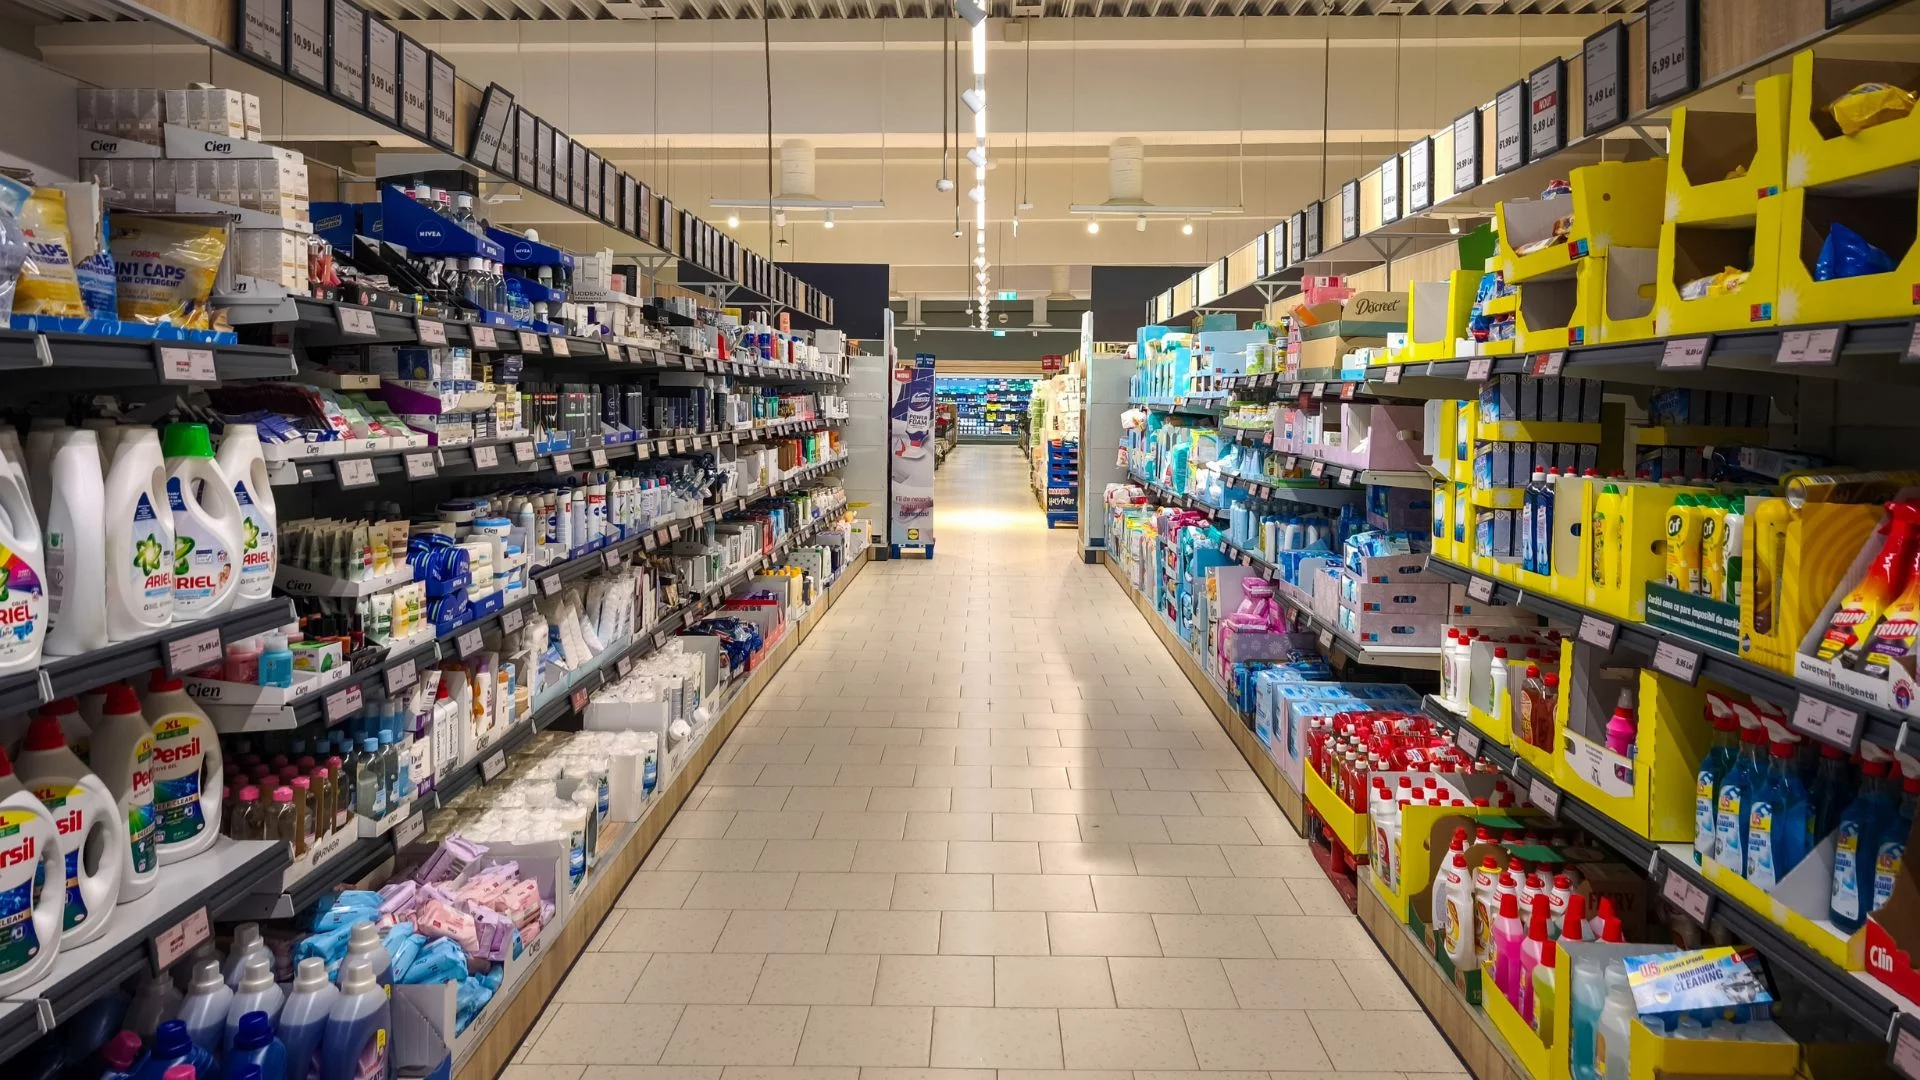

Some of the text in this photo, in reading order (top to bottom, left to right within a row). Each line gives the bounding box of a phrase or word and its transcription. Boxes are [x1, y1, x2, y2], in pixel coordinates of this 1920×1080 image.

[293, 32, 323, 58] 10,99 Lei
[1652, 47, 1685, 75] 6,99 Lei
[371, 73, 394, 96] 9,99 Lei
[404, 91, 425, 112] 6,99 Lei
[1588, 82, 1616, 108] 3,49 Lei
[1533, 114, 1556, 135] 9,89 Lei
[90, 140, 118, 153] Cien
[204, 140, 232, 153] Cien
[28, 241, 68, 257] CAPS
[143, 262, 187, 280] CAPS
[135, 277, 181, 288] DETERGENT
[1355, 298, 1401, 315] Discreet
[306, 444, 320, 455] Cien
[1668, 517, 1681, 534] Cif
[243, 550, 270, 566] ARIEL
[144, 572, 172, 589] ARIEL
[174, 576, 216, 590] RIEL
[0, 605, 34, 625] RIEL
[1830, 611, 1870, 625] TRIUMF
[211, 639, 220, 649] Lei
[1685, 662, 1693, 670] Lei
[186, 684, 221, 699] Cien
[165, 719, 182, 730] XL
[153, 736, 201, 762] Persil
[56, 809, 83, 836] sil
[0, 837, 34, 869] rsil
[0, 912, 25, 928] LEAN
[1869, 944, 1894, 973] Clin
[1640, 960, 1661, 978] W5
[1675, 962, 1716, 982] THOROUGH
[1673, 968, 1724, 994] CLEANING
